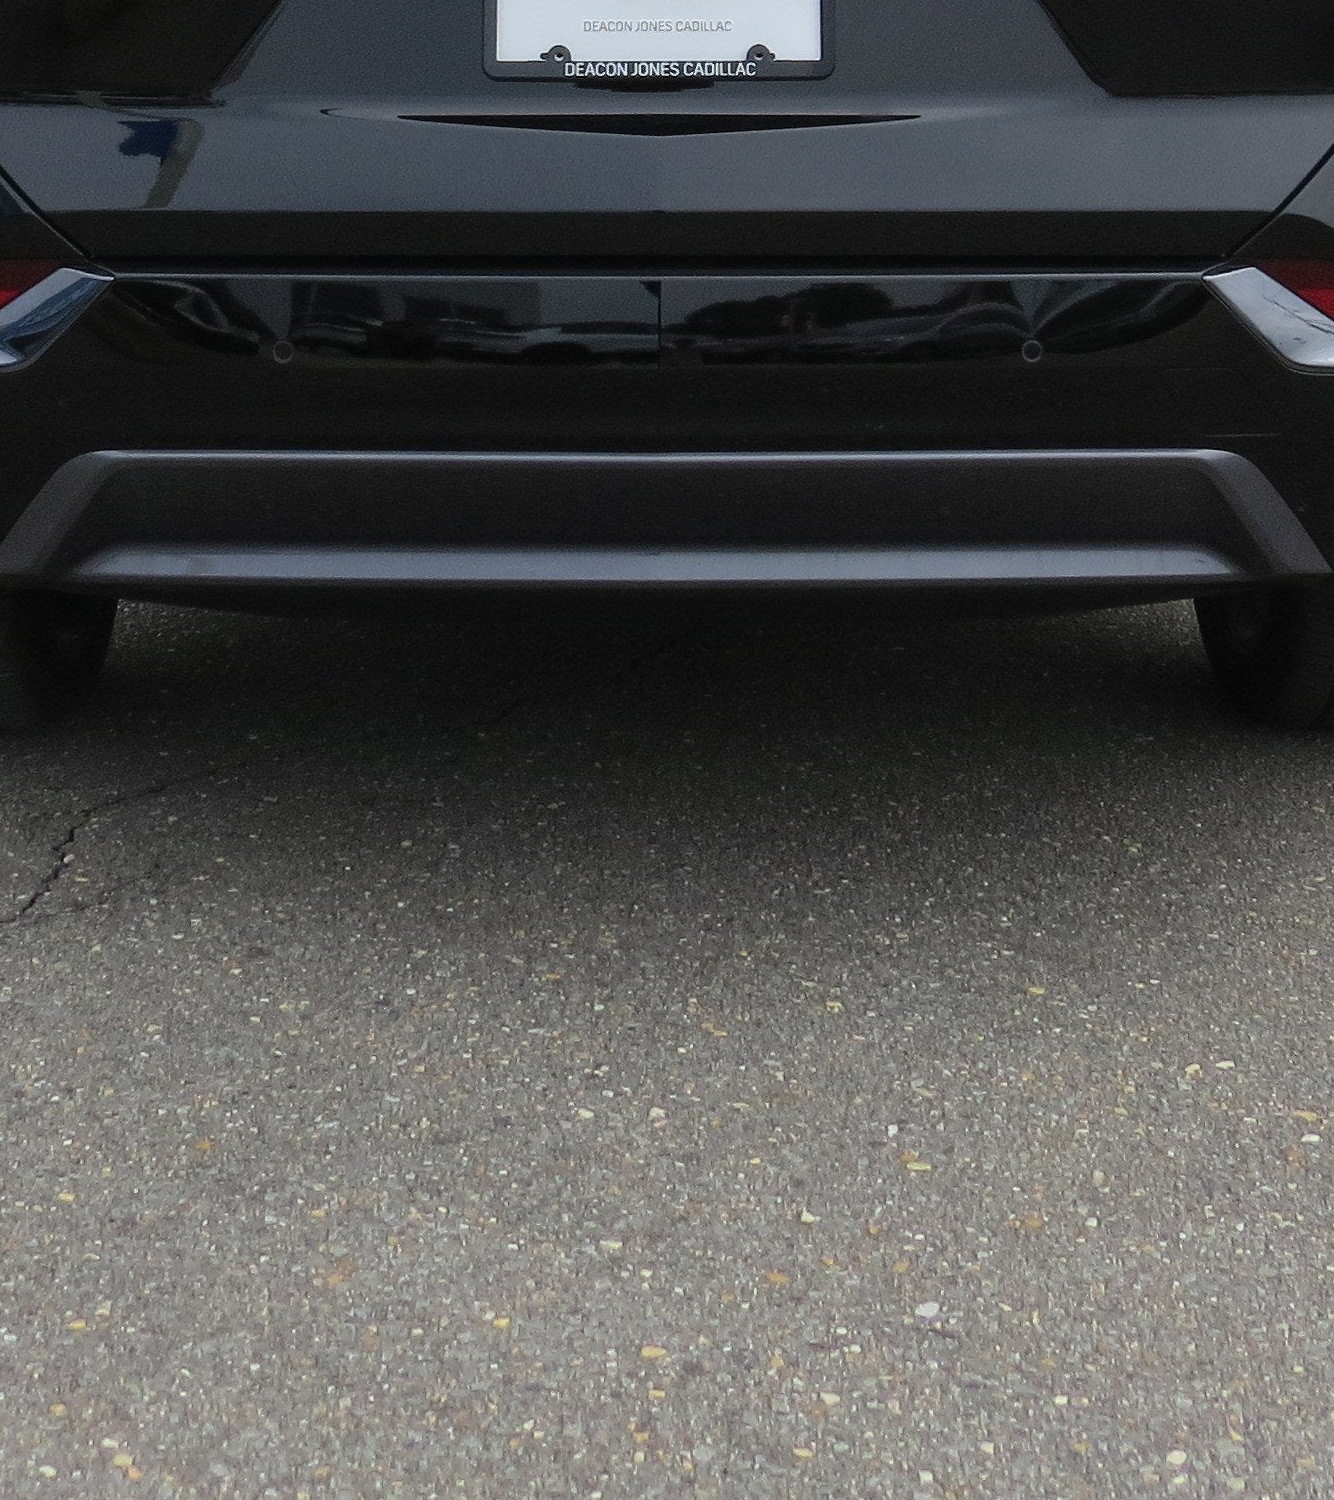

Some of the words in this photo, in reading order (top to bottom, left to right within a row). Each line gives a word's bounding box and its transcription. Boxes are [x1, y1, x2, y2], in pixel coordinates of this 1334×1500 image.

[583, 20, 633, 32] DEACON
[635, 20, 673, 32] JONES
[675, 20, 732, 32] CADILLAC
[564, 62, 630, 77] DEACON
[631, 62, 680, 77] JONES
[683, 62, 757, 77] CADILLAC
